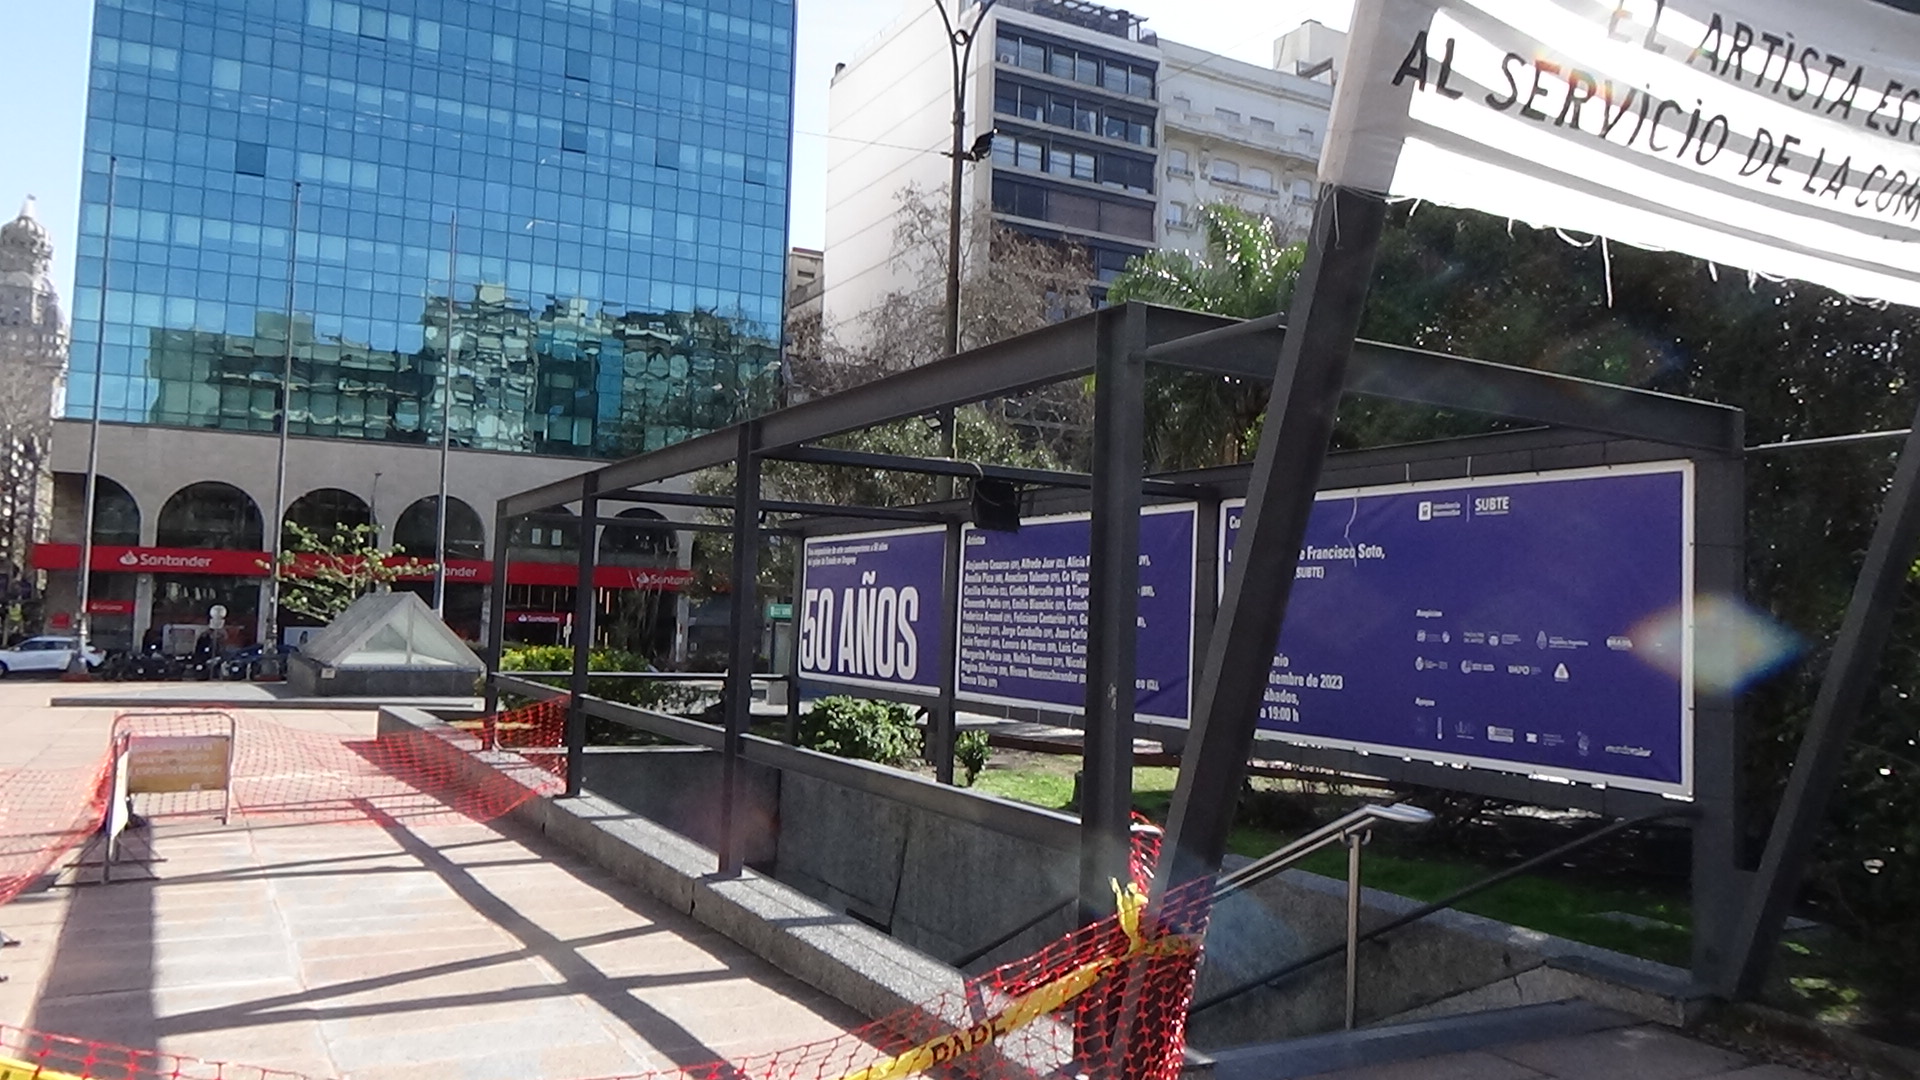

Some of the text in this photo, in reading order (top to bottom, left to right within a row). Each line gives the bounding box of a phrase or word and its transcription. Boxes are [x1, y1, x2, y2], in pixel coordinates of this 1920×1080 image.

[1391, 29, 1464, 100] AL
[1738, 127, 1801, 185] DE
[1802, 147, 1852, 200] LA
[1475, 496, 1510, 511] SUBTE
[1307, 544, 1356, 560] Francisco
[1357, 543, 1386, 559] Soto,
[140, 553, 212, 568] Santander
[650, 573, 694, 585] Santand
[801, 570, 918, 681] 50 AÑOS
[1272, 653, 1289, 667] nio
[1306, 673, 1319, 688] de
[1319, 674, 1344, 690] 2023
[1268, 705, 1291, 721] 19:00
[1292, 708, 1299, 722] h
